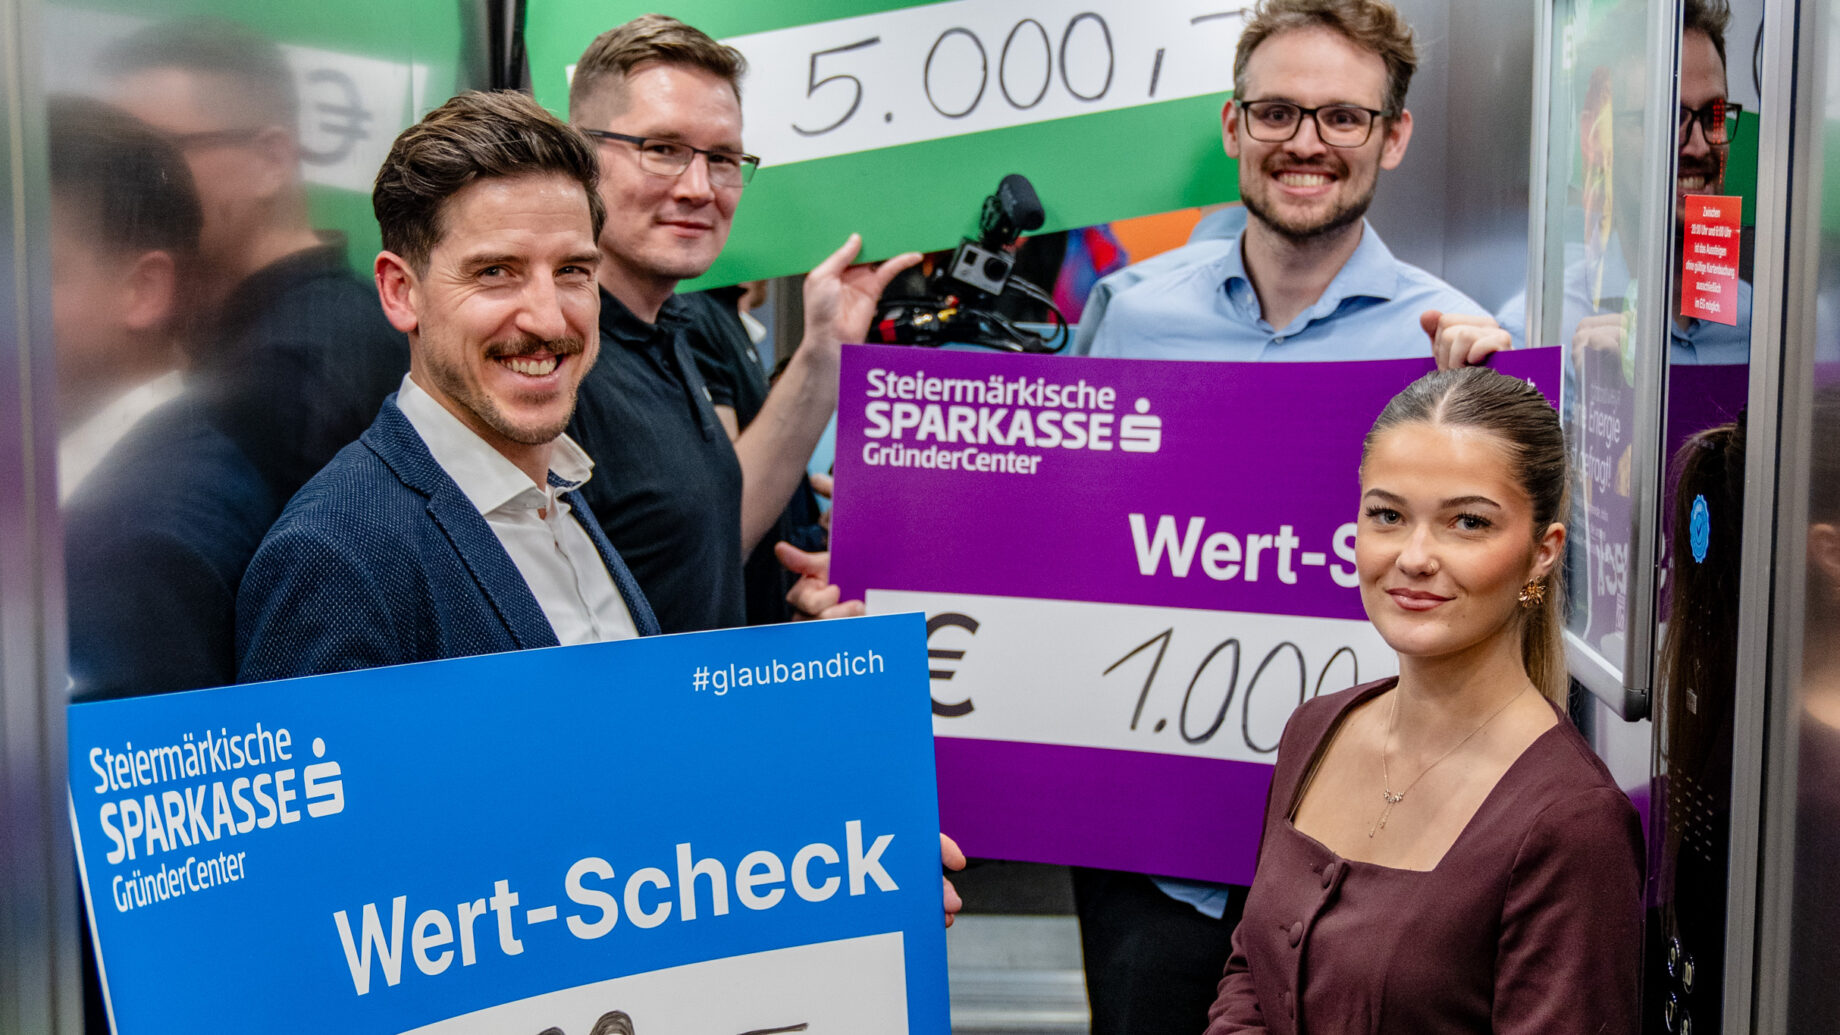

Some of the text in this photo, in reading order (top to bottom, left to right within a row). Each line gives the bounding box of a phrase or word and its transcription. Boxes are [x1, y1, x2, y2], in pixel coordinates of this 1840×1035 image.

[866, 368, 1115, 411] Steiermärkische
[863, 401, 1114, 451] SPARKASSE
[1588, 401, 1621, 450] Energie
[862, 442, 1042, 475] GründerCenter
[692, 649, 884, 697] #glaubandich
[927, 612, 980, 718] €
[89, 722, 293, 794] Steiermärkische
[100, 768, 301, 865] SPARKASSE
[112, 851, 246, 913] GründerCenter
[333, 819, 900, 996] Wert-Scheck
